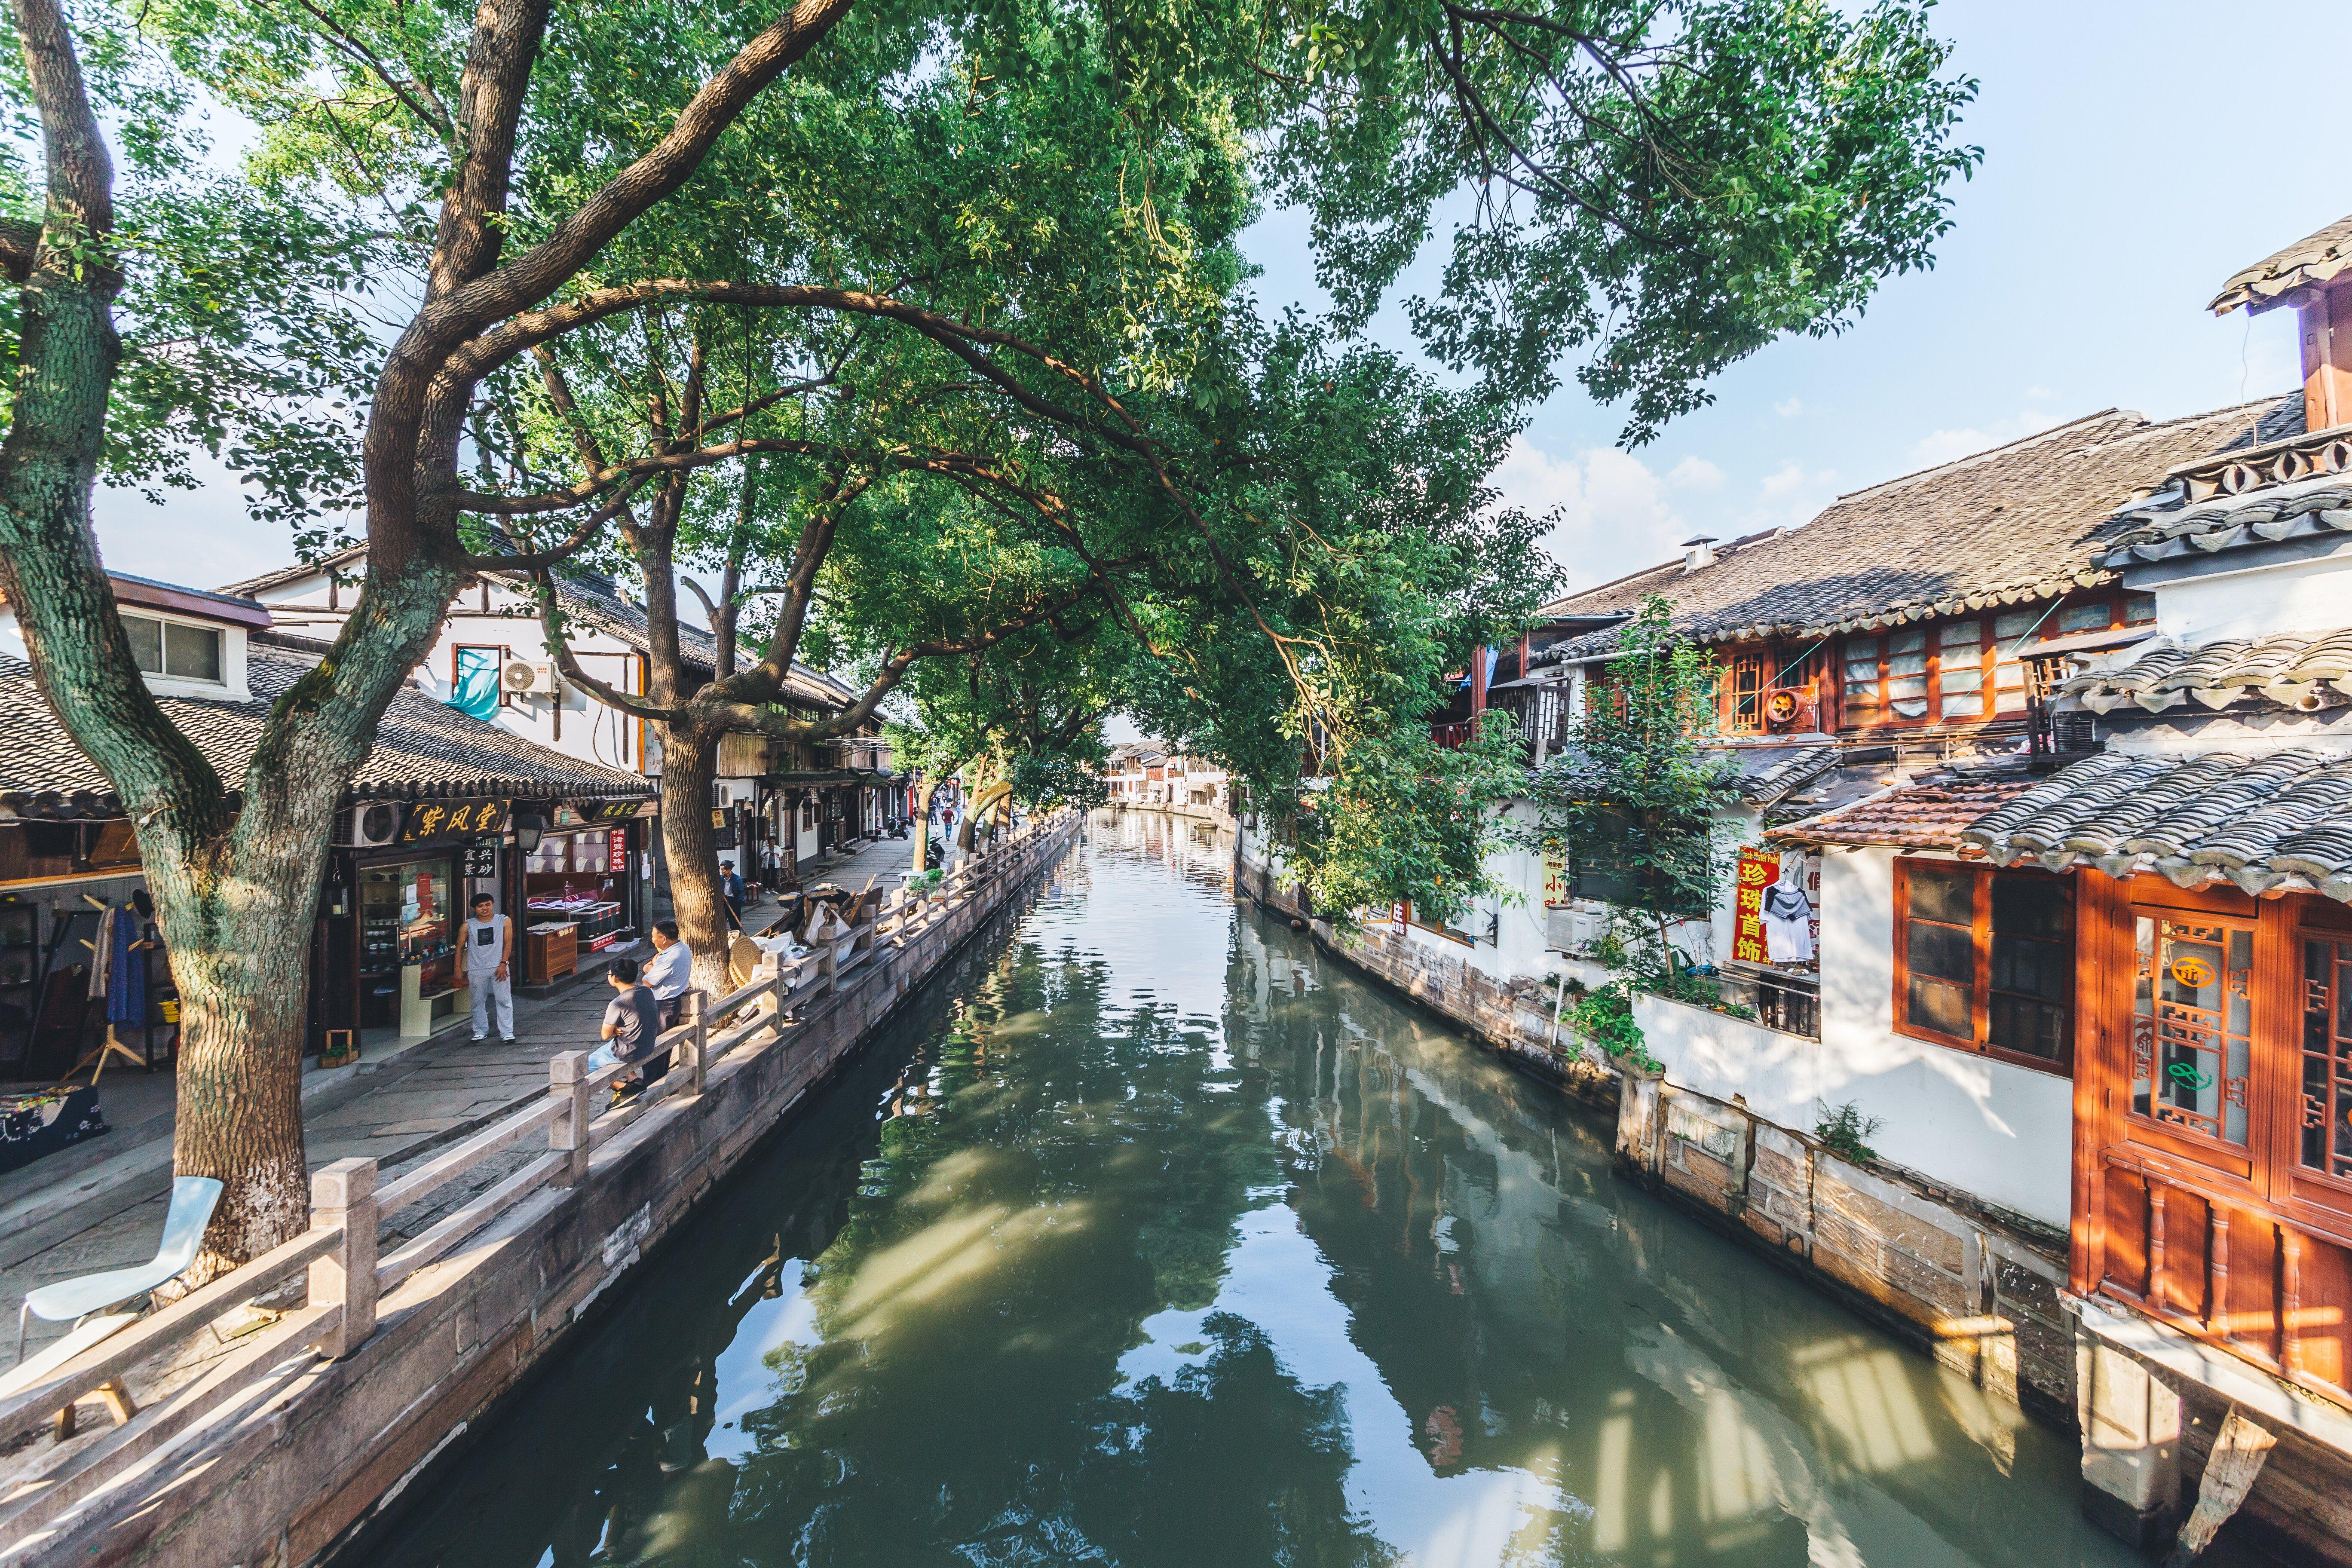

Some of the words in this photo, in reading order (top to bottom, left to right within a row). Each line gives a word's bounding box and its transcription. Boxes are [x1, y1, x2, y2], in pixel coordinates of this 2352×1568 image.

[420, 802, 496, 836] 紫风堂
[464, 849, 493, 860] 宜兴
[1741, 851, 1753, 860] resh
[465, 863, 493, 876] 紫砂
[1737, 863, 1767, 962] 珍珠首饰
